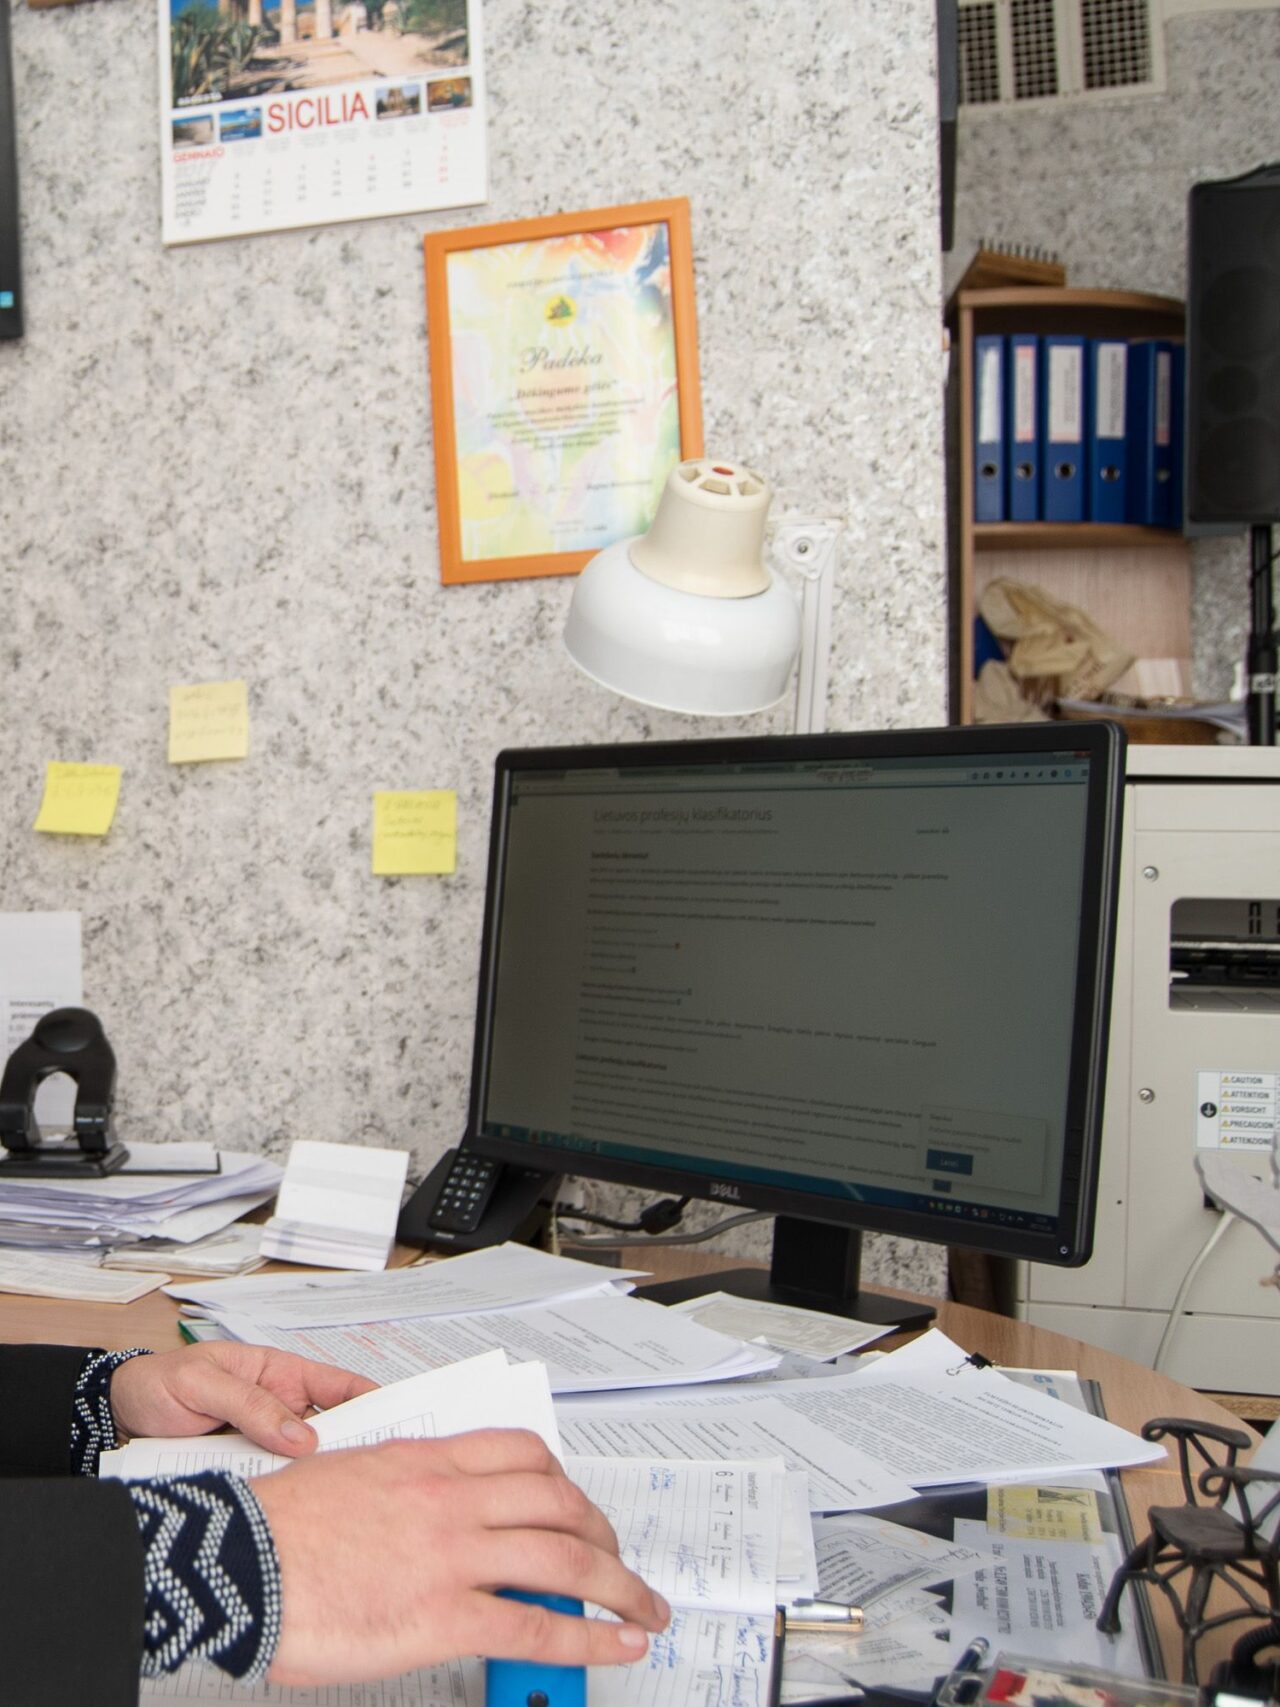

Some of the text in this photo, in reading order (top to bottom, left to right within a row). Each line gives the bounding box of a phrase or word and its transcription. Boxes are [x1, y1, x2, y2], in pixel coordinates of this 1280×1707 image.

[267, 91, 369, 134] SICILIA
[519, 345, 605, 374] Padėka
[594, 807, 773, 825] Lietuvos profesijų klasifikatorius
[1231, 1076, 1263, 1084] CAUTION
[1230, 1090, 1270, 1099] ATTENTION
[1231, 1105, 1266, 1114] VORSICHT
[710, 1182, 741, 1200] DELL
